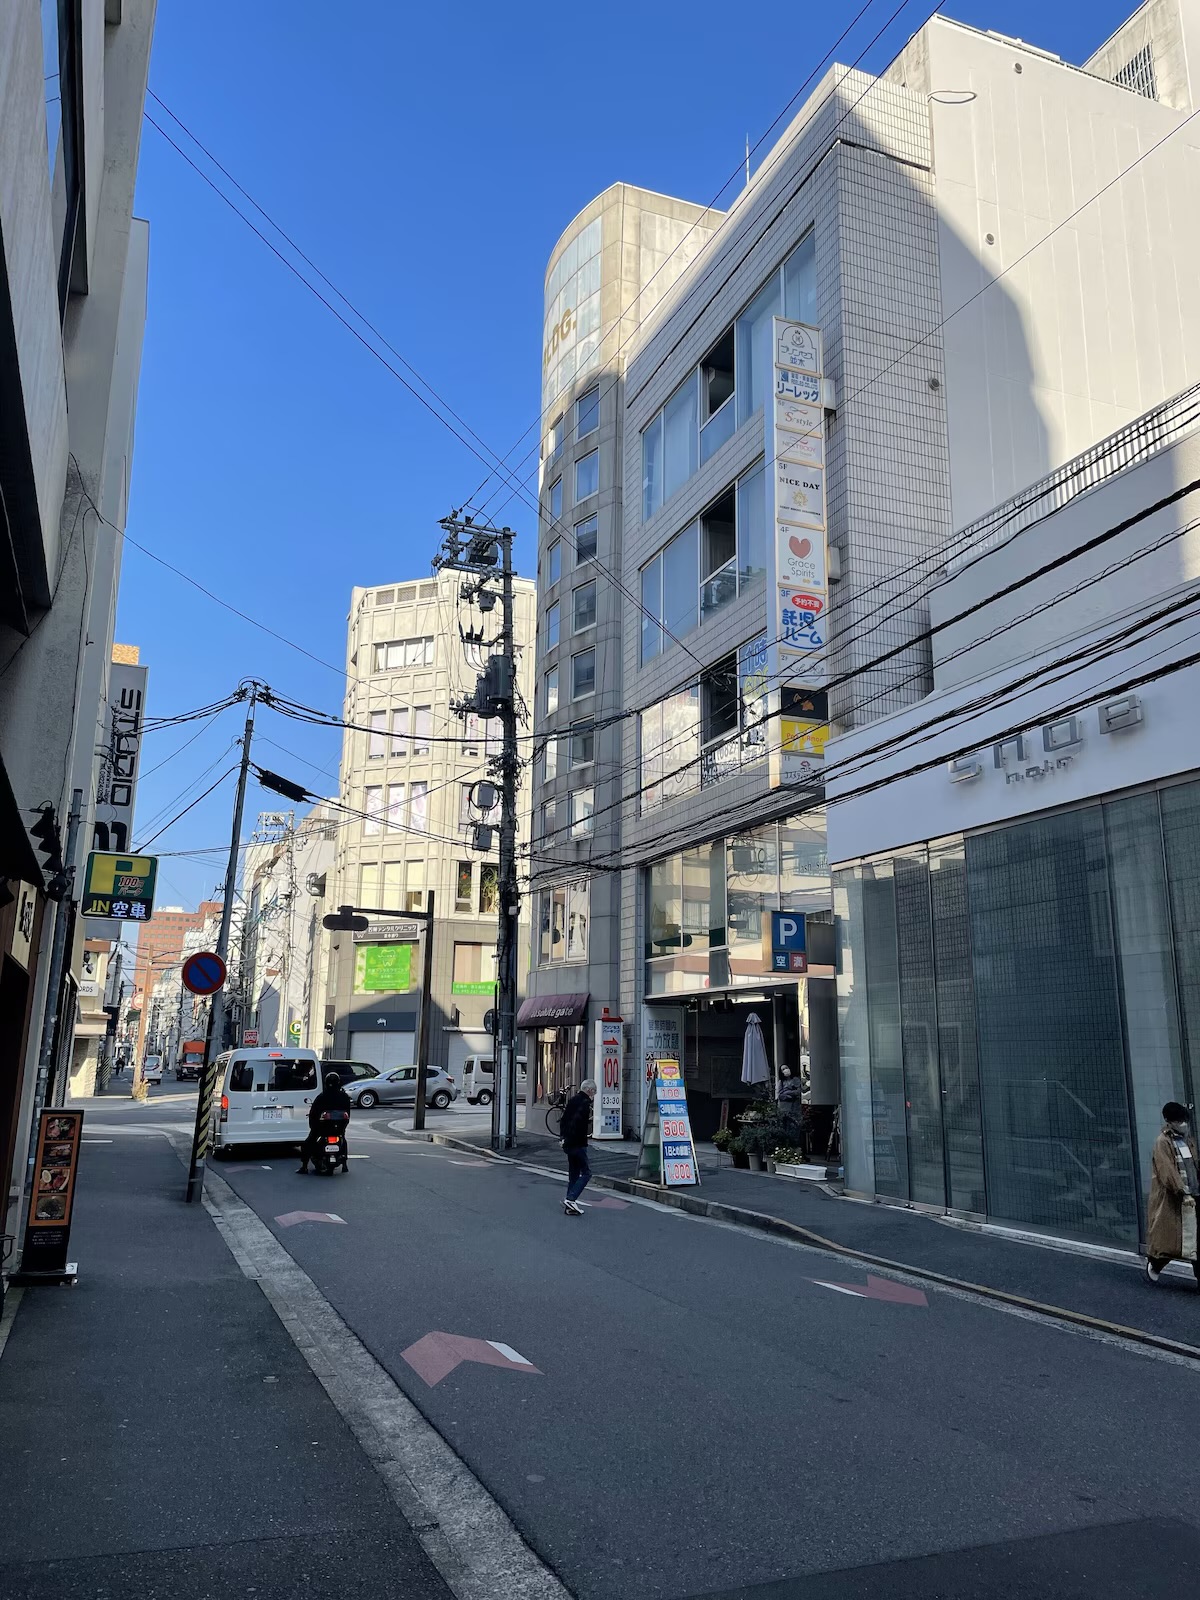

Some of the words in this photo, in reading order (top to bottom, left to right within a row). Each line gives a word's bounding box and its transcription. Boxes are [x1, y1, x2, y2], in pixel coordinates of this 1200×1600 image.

[777, 381, 819, 402] リーレッグ
[778, 462, 788, 470] 5F
[779, 476, 800, 487] NICE
[803, 481, 820, 490] DAY
[780, 526, 790, 534] 4F
[787, 557, 816, 570] Grace
[791, 566, 815, 579] Spirits
[780, 589, 791, 597] 3F
[794, 597, 820, 608] 予約不要
[782, 608, 815, 629] 託児
[785, 627, 823, 645] ルーム
[89, 854, 151, 895] P
[91, 899, 110, 912] IN
[111, 901, 147, 918] 空車
[779, 918, 798, 945] P
[776, 955, 786, 967] 空
[793, 956, 803, 967] 満
[554, 1007, 574, 1018] gate
[648, 1019, 677, 1031] 営業時間内
[646, 1033, 679, 1050] 止め放題
[602, 1096, 620, 1105] 23:30
